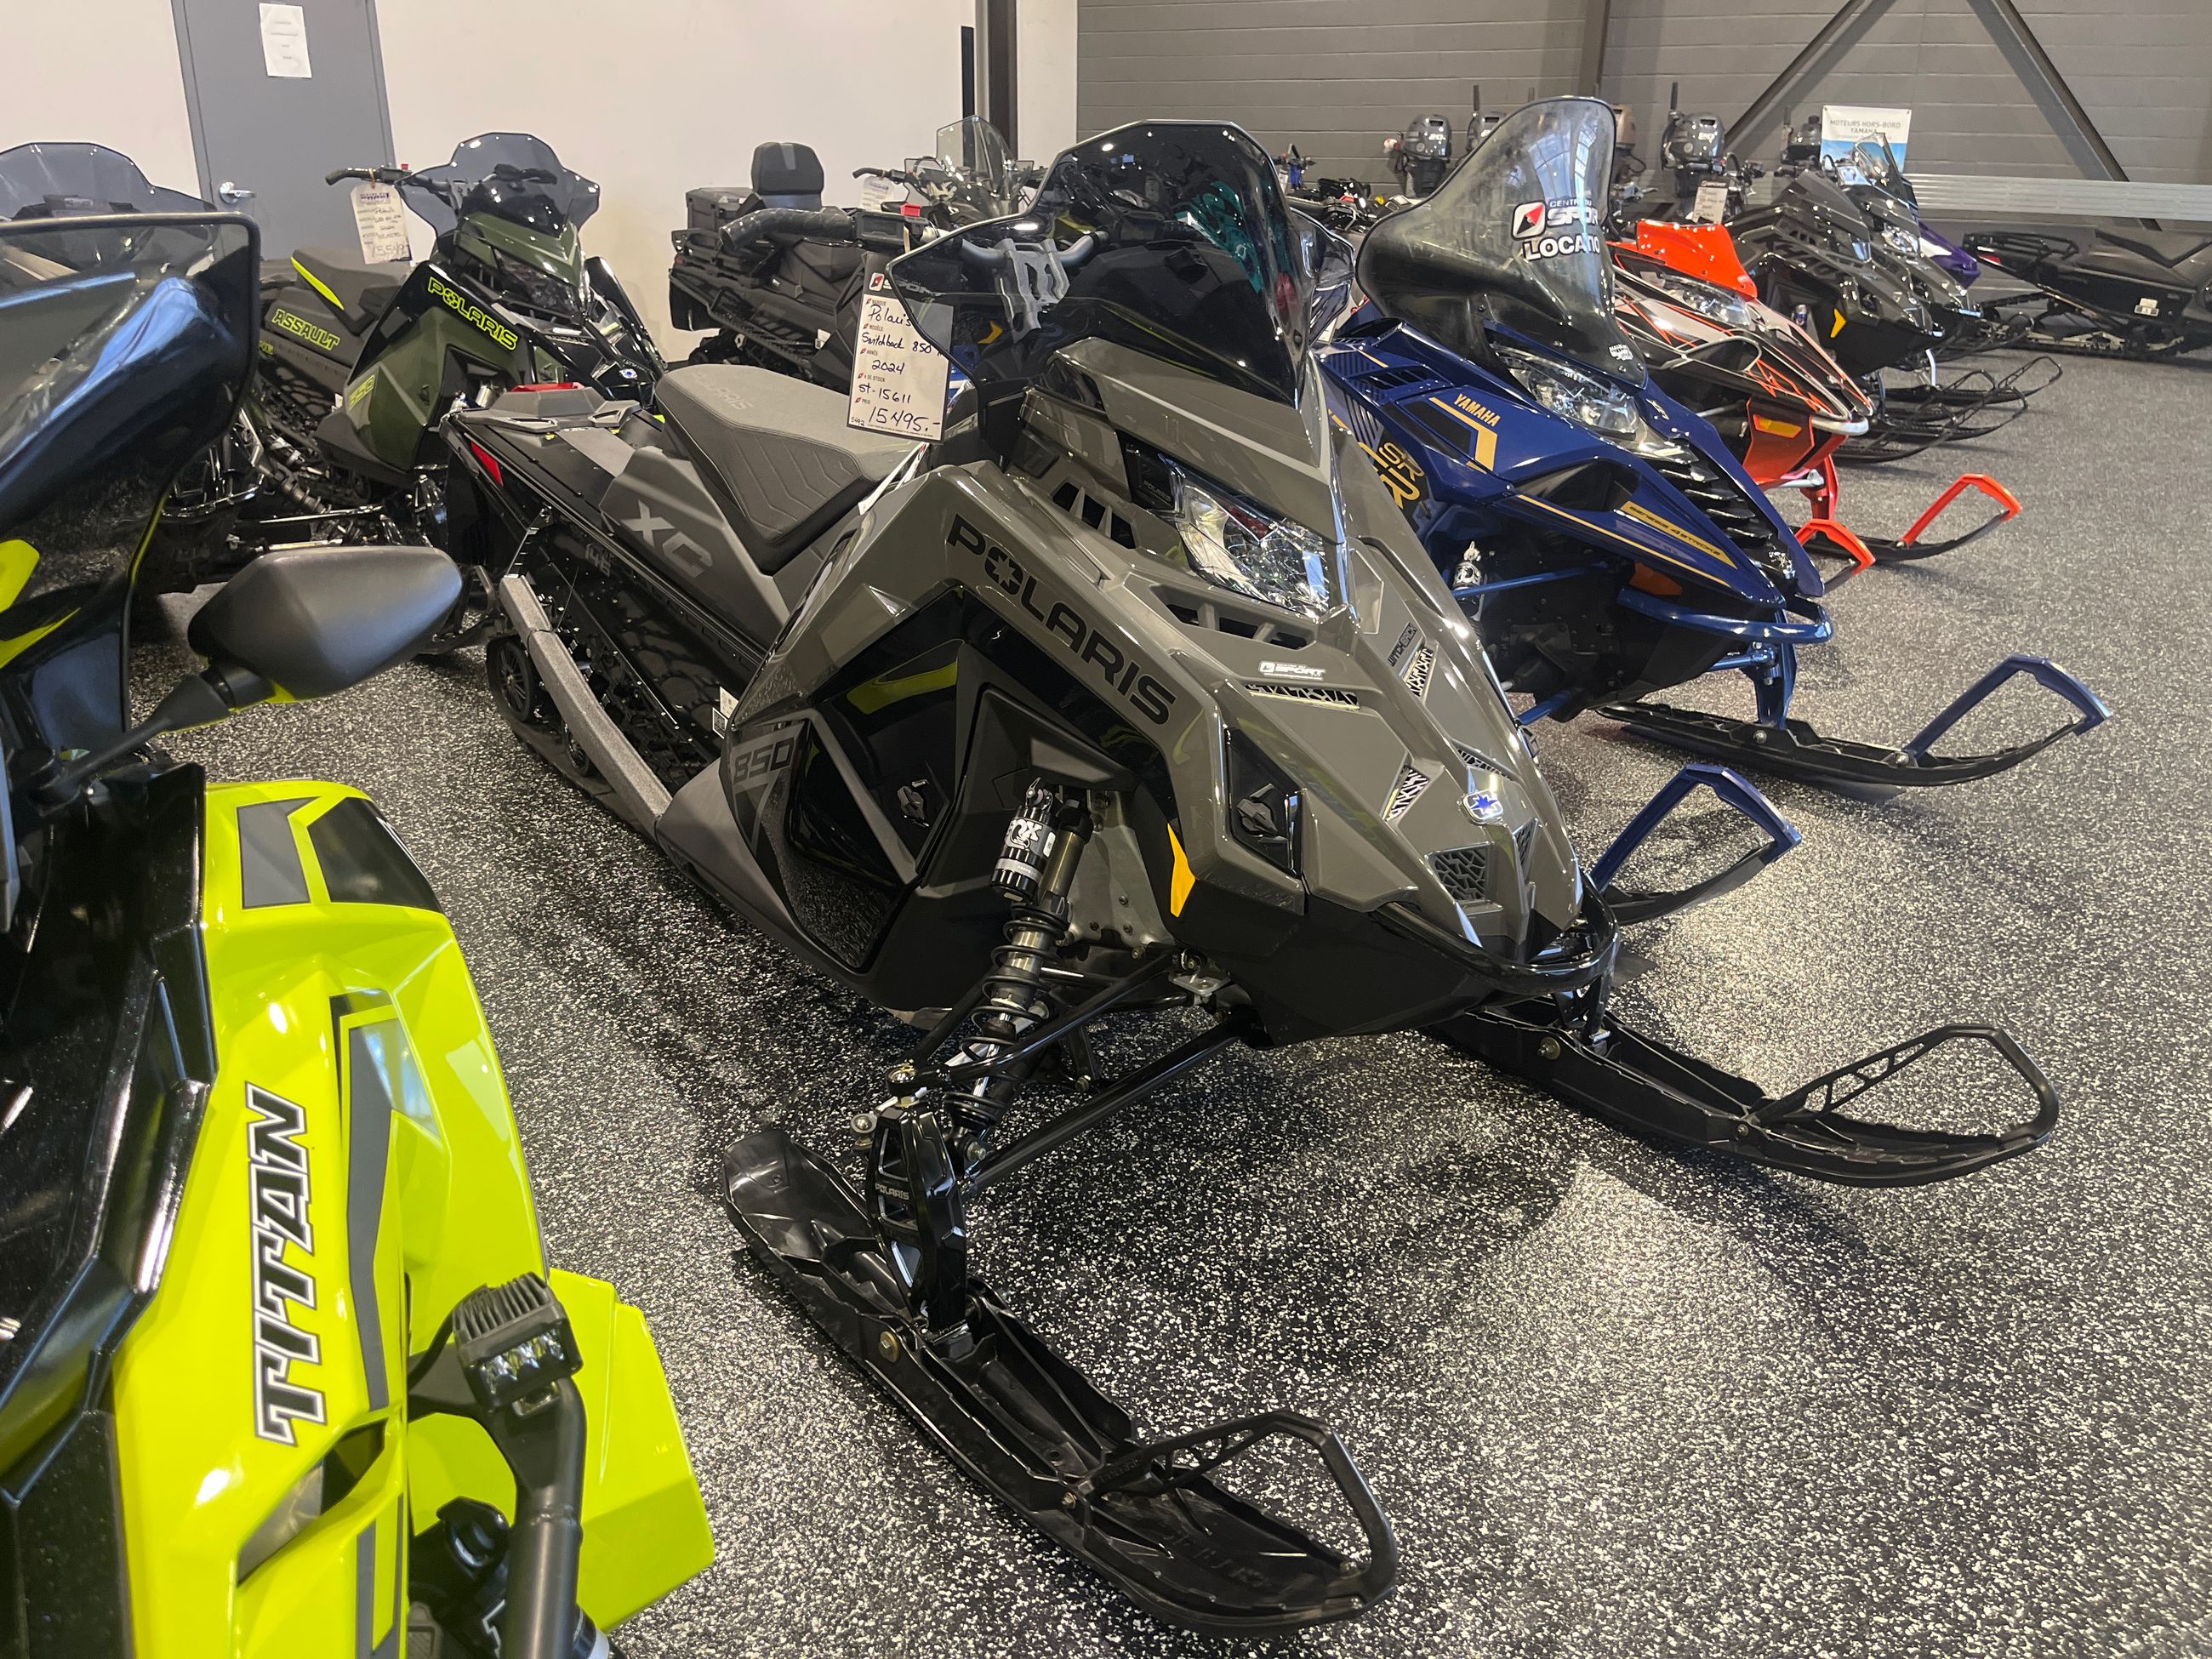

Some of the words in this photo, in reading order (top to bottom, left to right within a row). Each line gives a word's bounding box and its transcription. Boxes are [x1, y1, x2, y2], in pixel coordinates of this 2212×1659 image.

[1549, 198, 1582, 208] CENTR
[271, 309, 340, 351] ASSAULT
[428, 276, 518, 351] POLARIS
[868, 304, 911, 327] Polaris
[862, 332, 904, 349] Switchback
[912, 341, 932, 354] 850
[871, 360, 904, 375] 2024
[1453, 393, 1501, 427] YAMAHA
[1378, 442, 1425, 482] SR
[946, 513, 1177, 726] POLARIS
[733, 737, 795, 784] 850
[875, 1182, 909, 1200] POLARIS
[244, 1080, 328, 1447] TITAN
